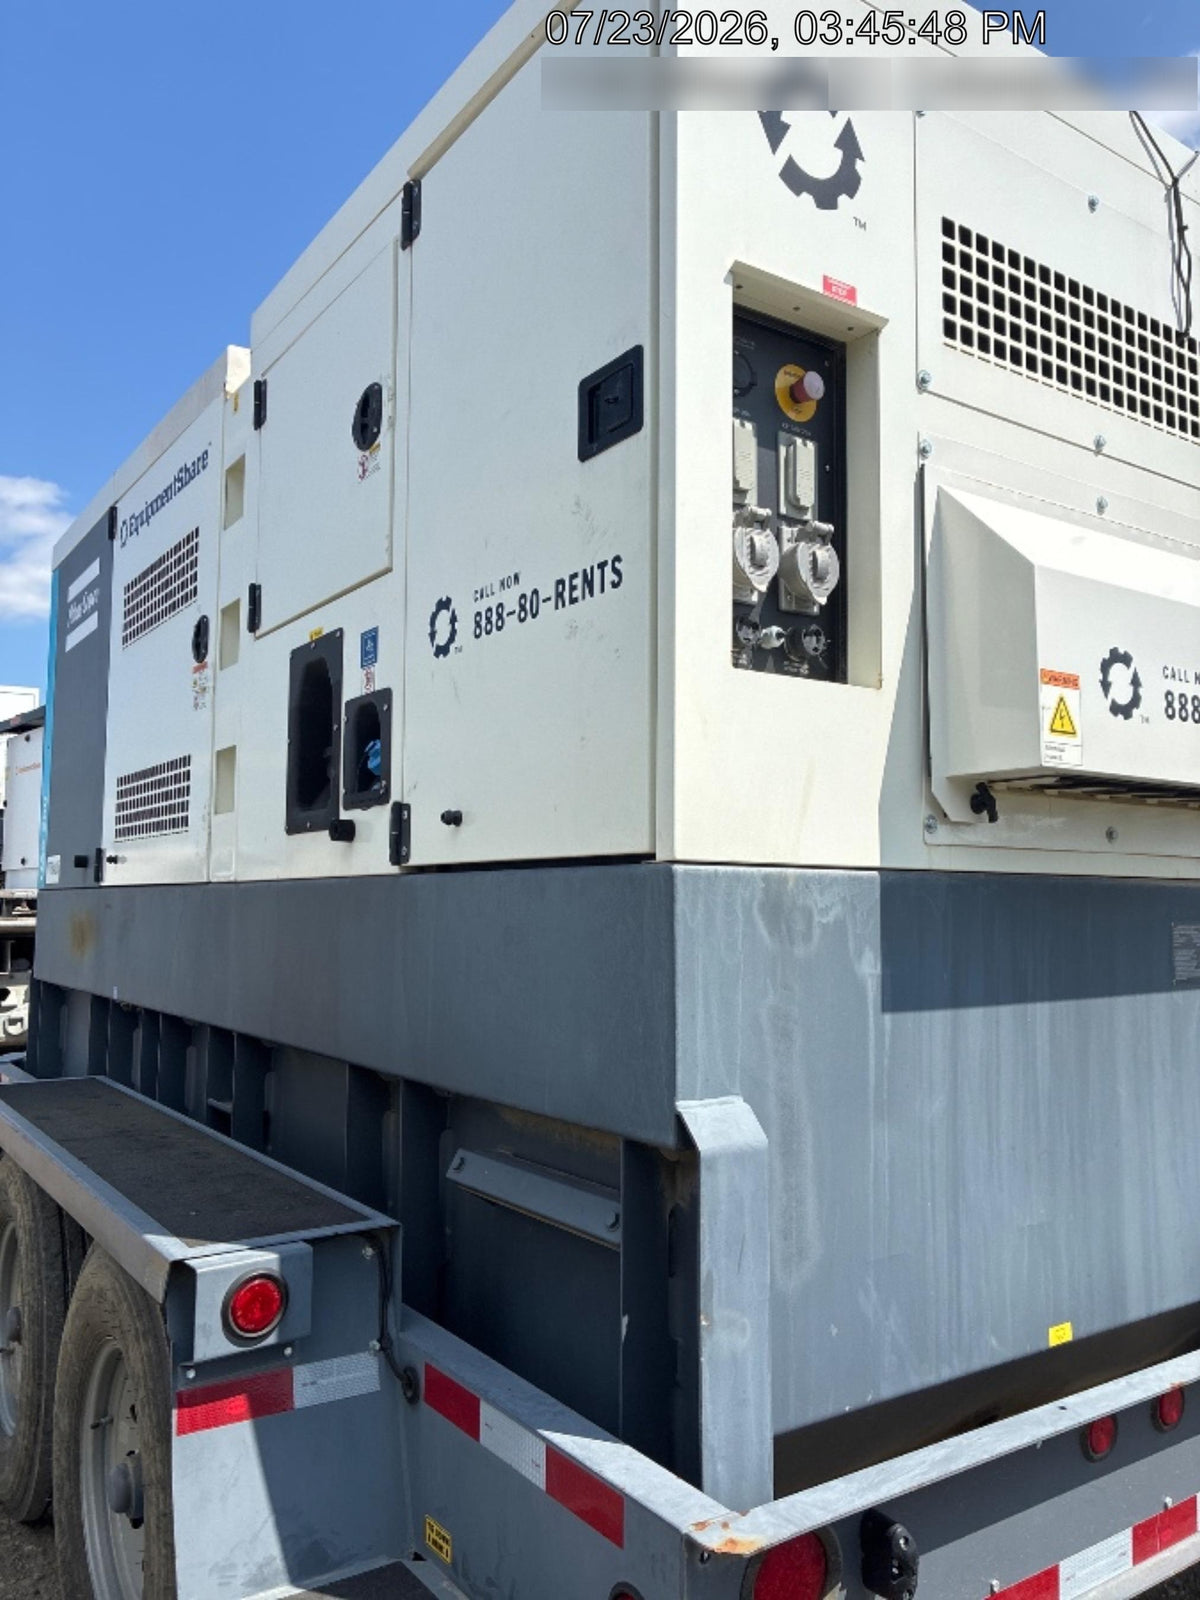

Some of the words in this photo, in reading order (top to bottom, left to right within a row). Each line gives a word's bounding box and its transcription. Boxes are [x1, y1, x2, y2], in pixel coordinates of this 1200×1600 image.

[129, 448, 209, 538] EquipmentShare
[474, 583, 495, 602] CALL
[499, 572, 520, 592] NOW
[474, 554, 623, 640] 888-80-RENTS
[1162, 665, 1190, 684] CALL
